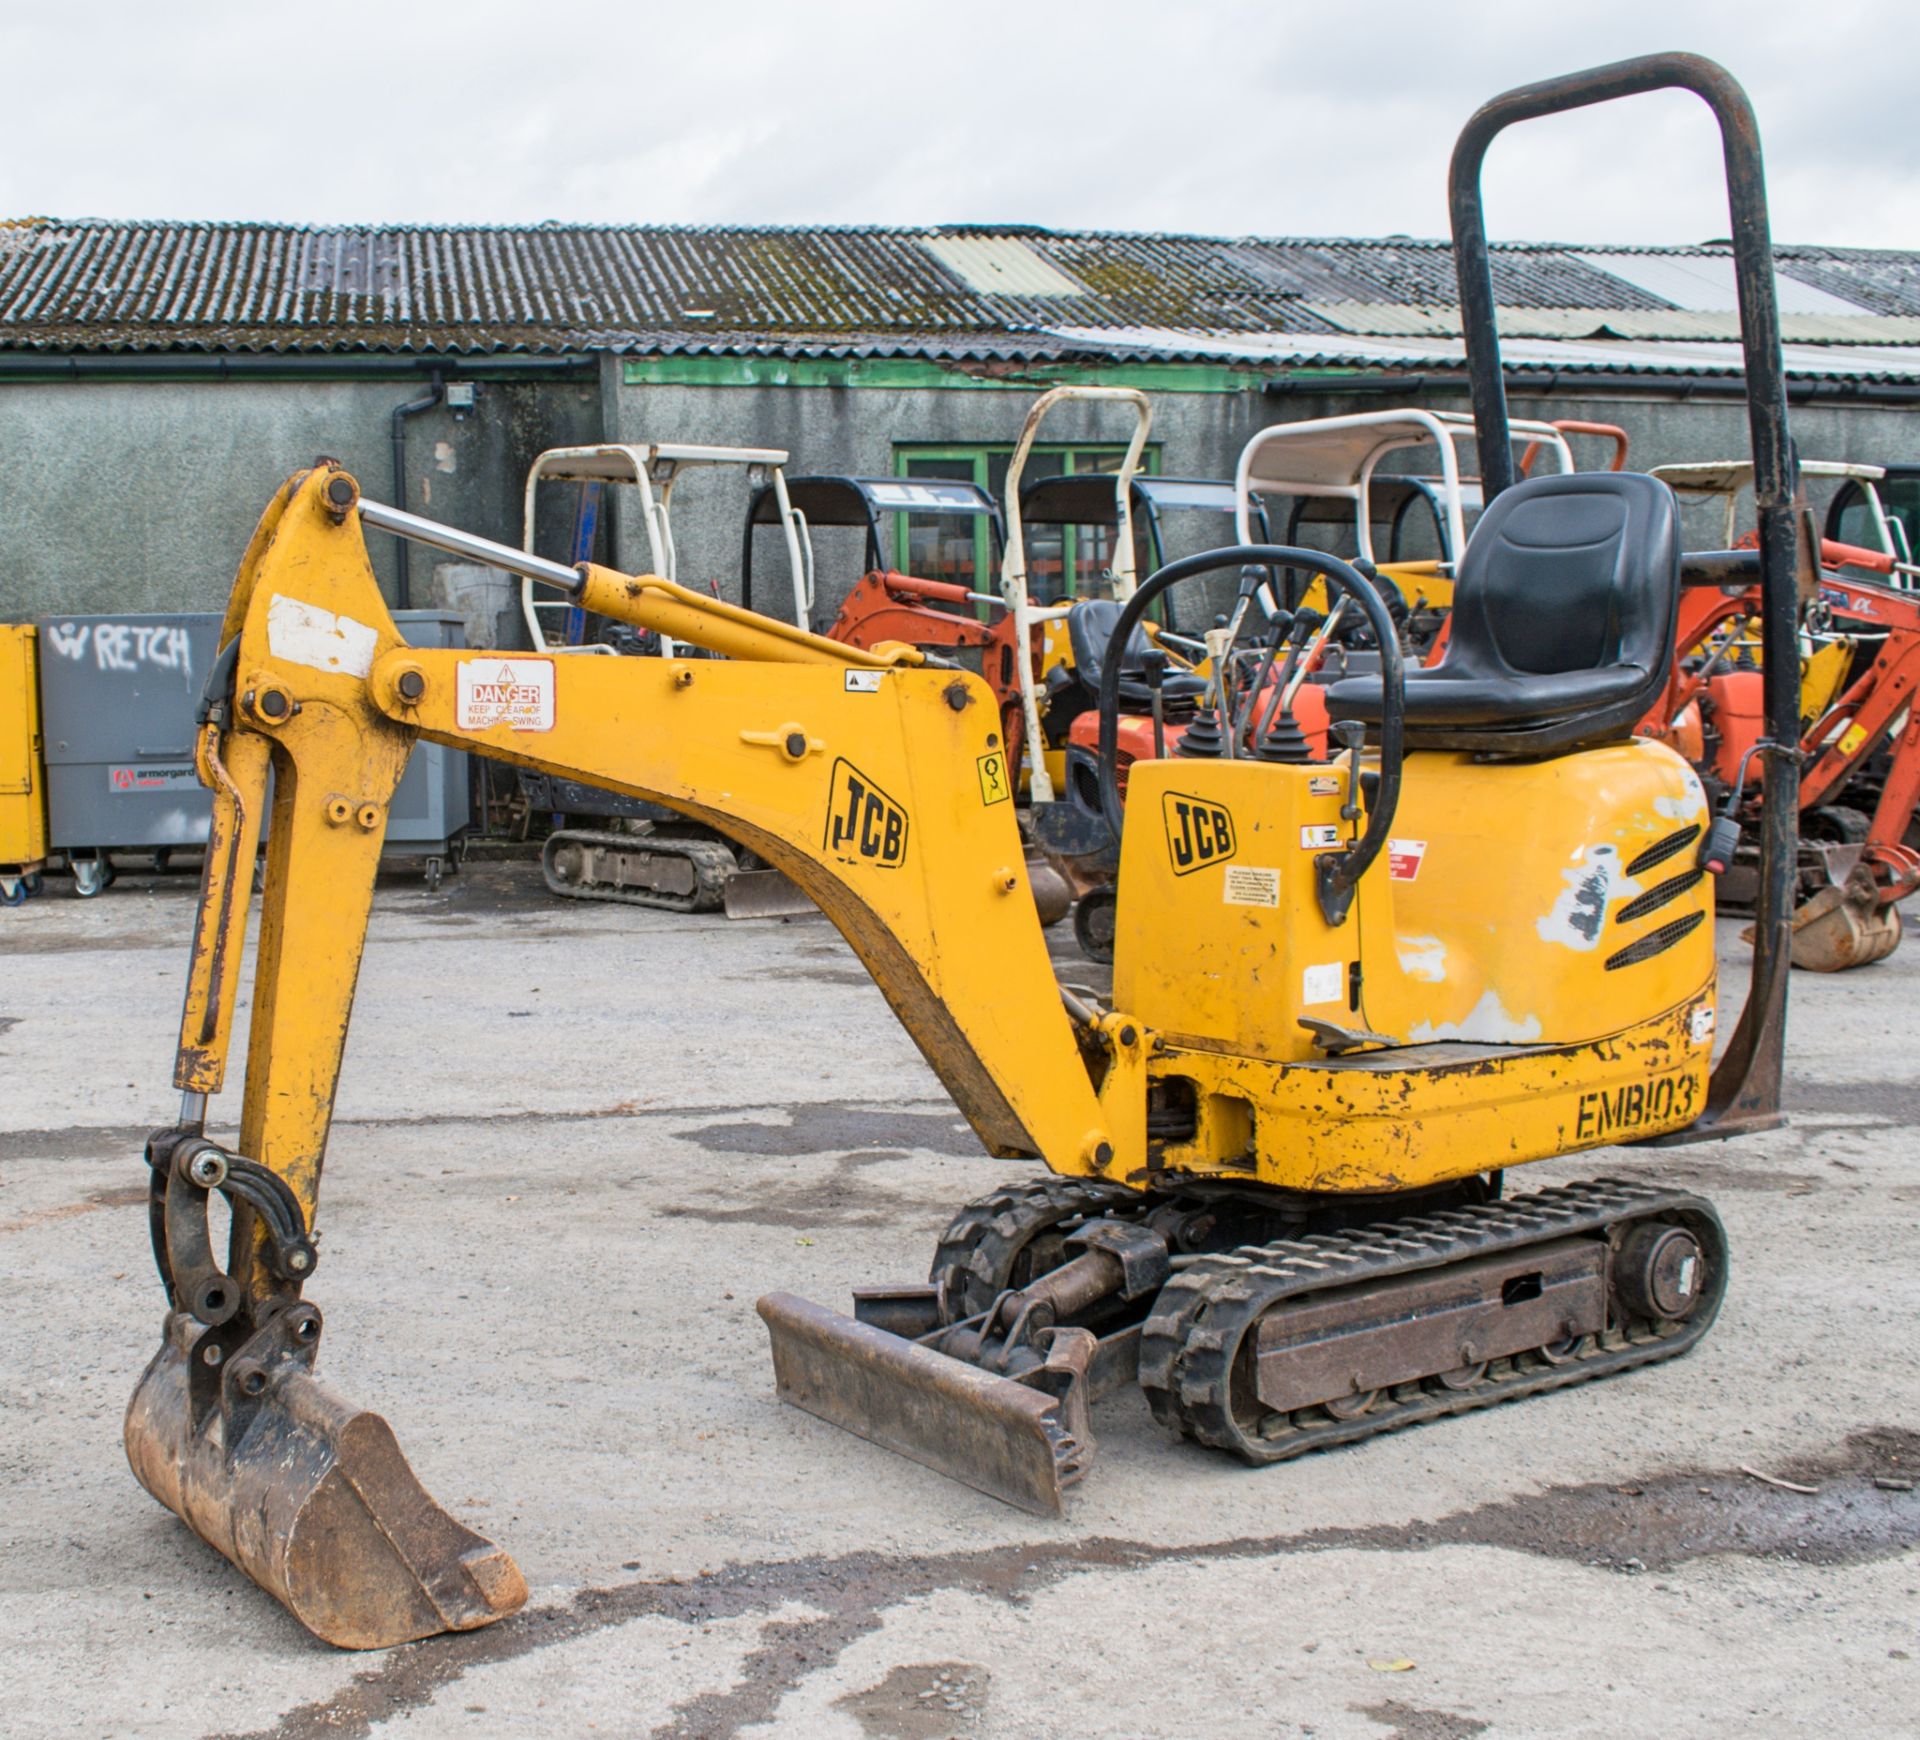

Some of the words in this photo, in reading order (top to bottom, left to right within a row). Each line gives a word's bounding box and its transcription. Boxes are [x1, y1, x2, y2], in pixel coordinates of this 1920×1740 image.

[473, 685, 539, 703] DANGER
[468, 704, 490, 714] KEEP
[496, 705, 525, 715] CLEAR
[137, 767, 195, 779] armorgard
[832, 774, 903, 861] JCB
[1174, 801, 1231, 867] JCB
